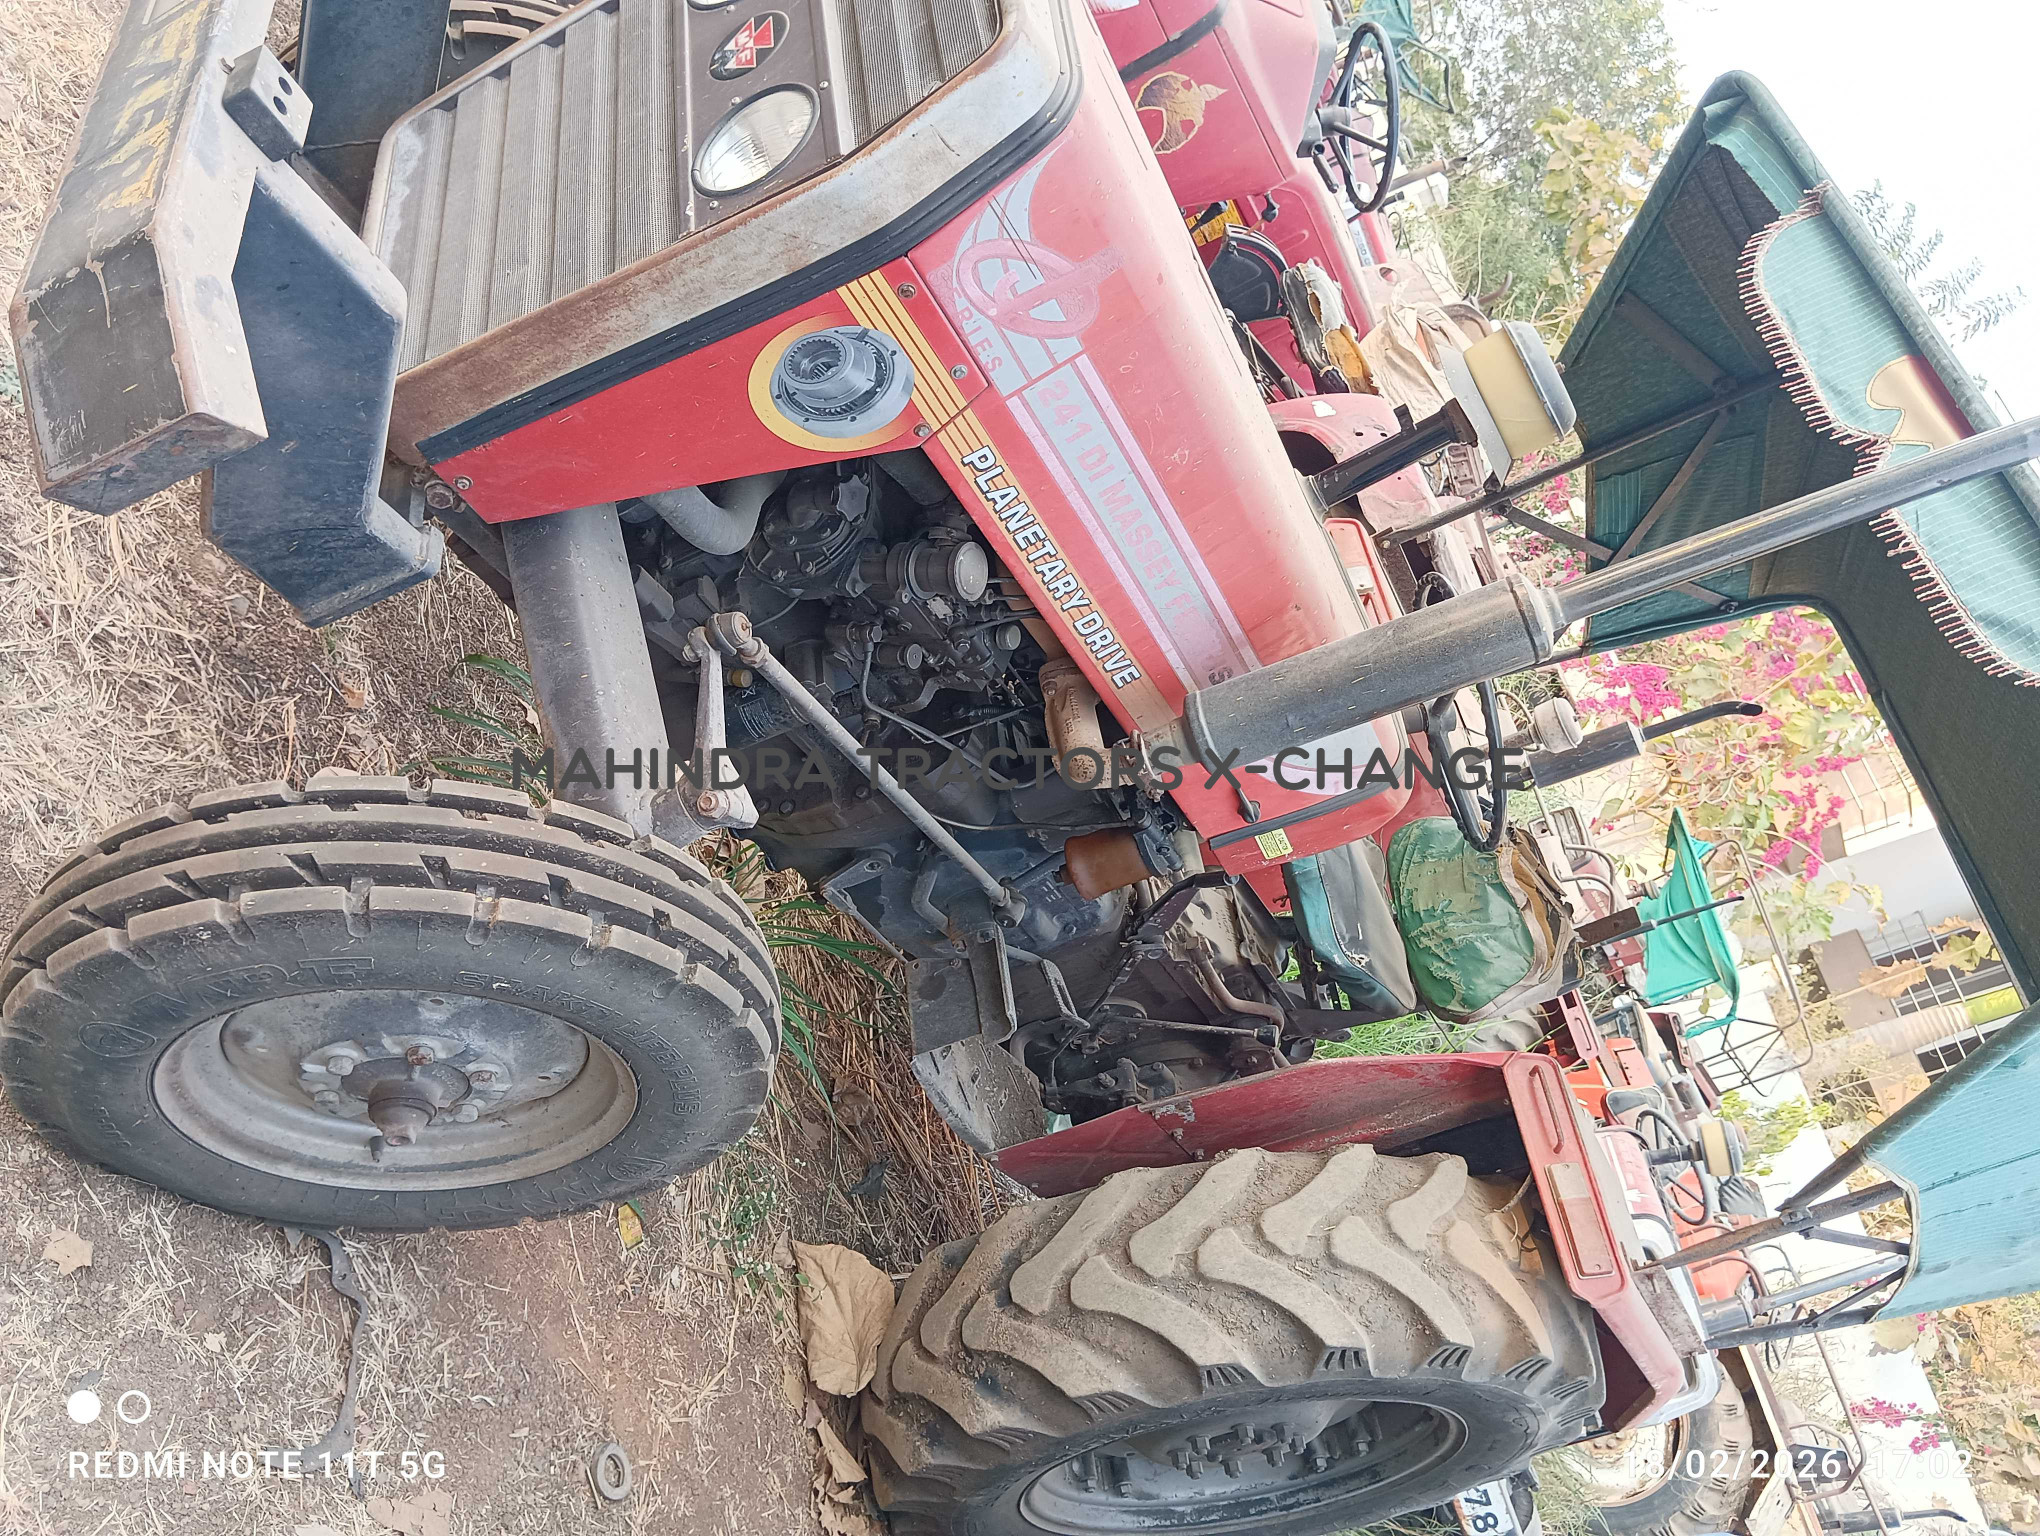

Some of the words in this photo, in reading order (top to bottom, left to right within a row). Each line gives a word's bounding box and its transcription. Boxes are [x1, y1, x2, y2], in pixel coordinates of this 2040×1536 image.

[961, 445, 1091, 624] PLANETARY
[1073, 610, 1142, 690] DRIVE
[1037, 379, 1093, 444] 241
[1076, 443, 1116, 484] DI
[1099, 479, 1183, 591] MASSEY
